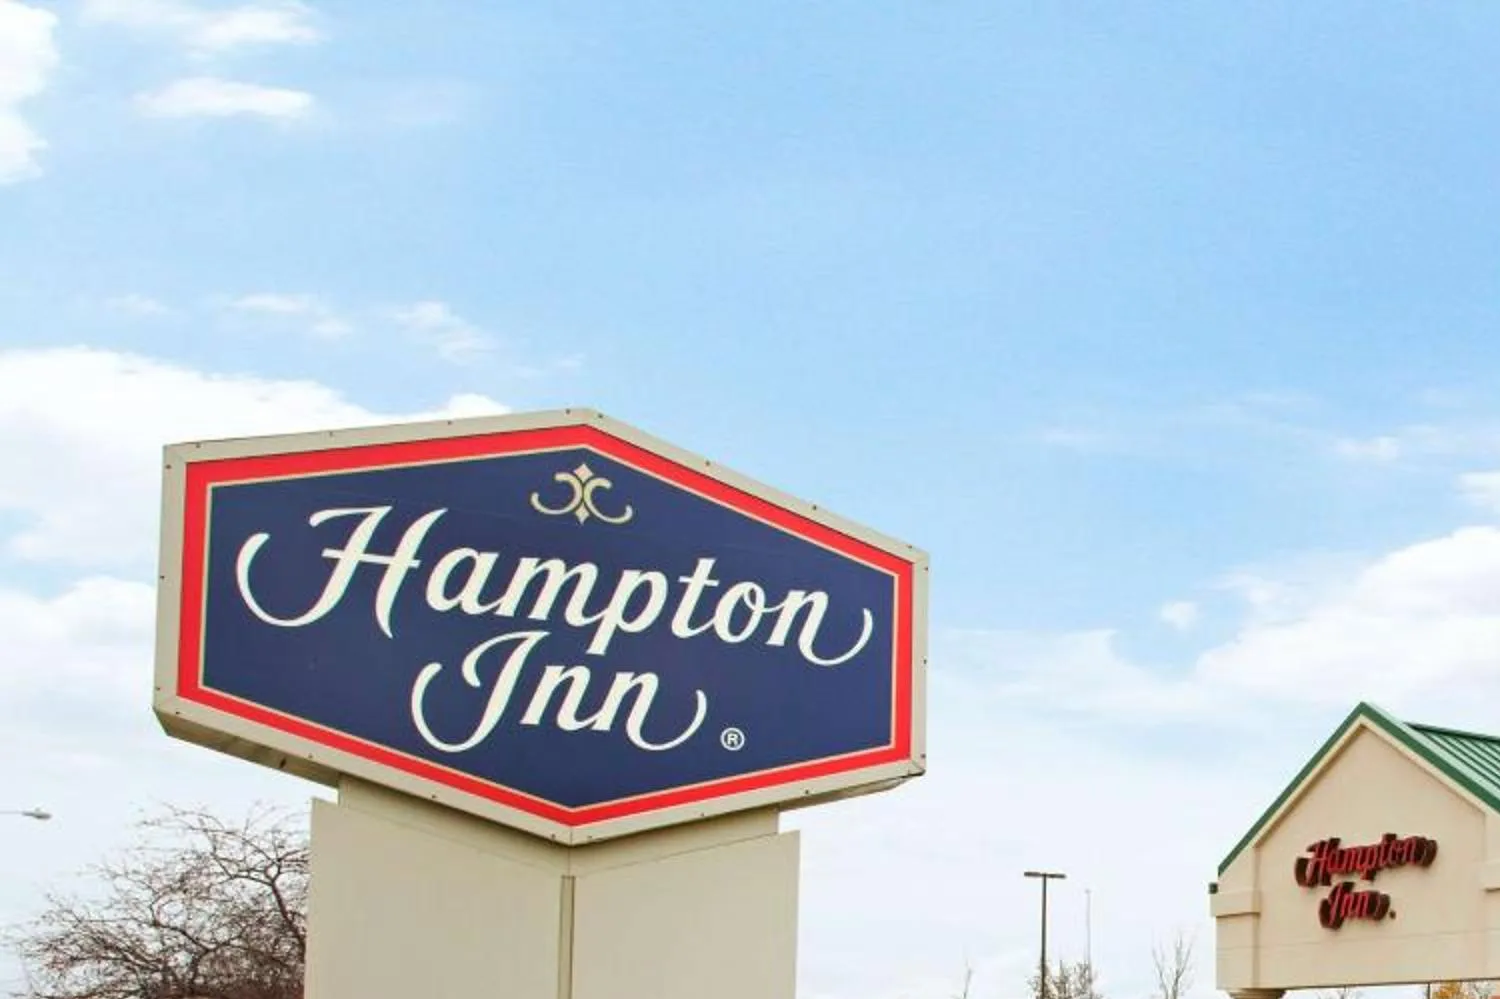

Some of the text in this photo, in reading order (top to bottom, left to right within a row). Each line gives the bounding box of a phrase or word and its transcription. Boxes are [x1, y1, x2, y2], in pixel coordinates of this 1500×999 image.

[235, 505, 873, 666] Hampton
[410, 629, 707, 753] Inn
[1294, 833, 1438, 889] Hampton
[1318, 881, 1391, 931] Inn
